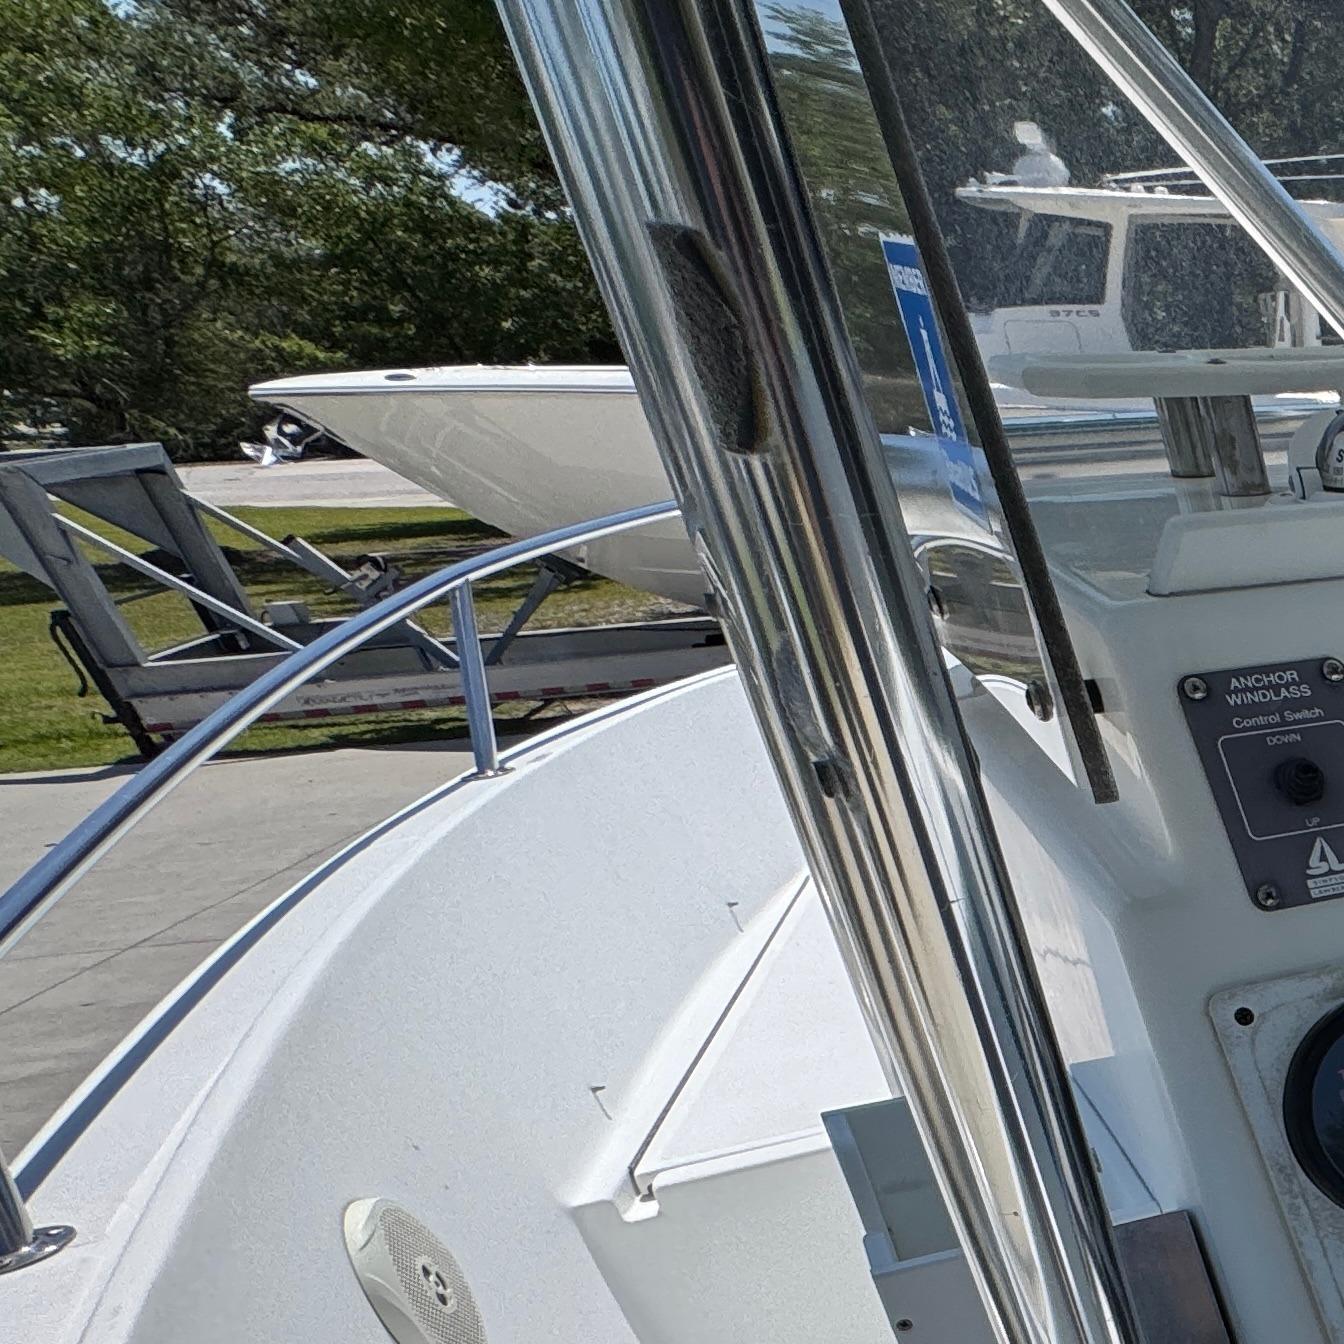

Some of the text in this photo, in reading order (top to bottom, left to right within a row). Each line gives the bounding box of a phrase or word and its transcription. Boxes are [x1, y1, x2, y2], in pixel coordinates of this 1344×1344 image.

[1230, 670, 1299, 690] ANCHOR
[1225, 685, 1312, 707] WINDLASS
[1232, 707, 1325, 729] Control Switch
[1267, 733, 1301, 747] DOWN
[1305, 816, 1321, 827] UP
